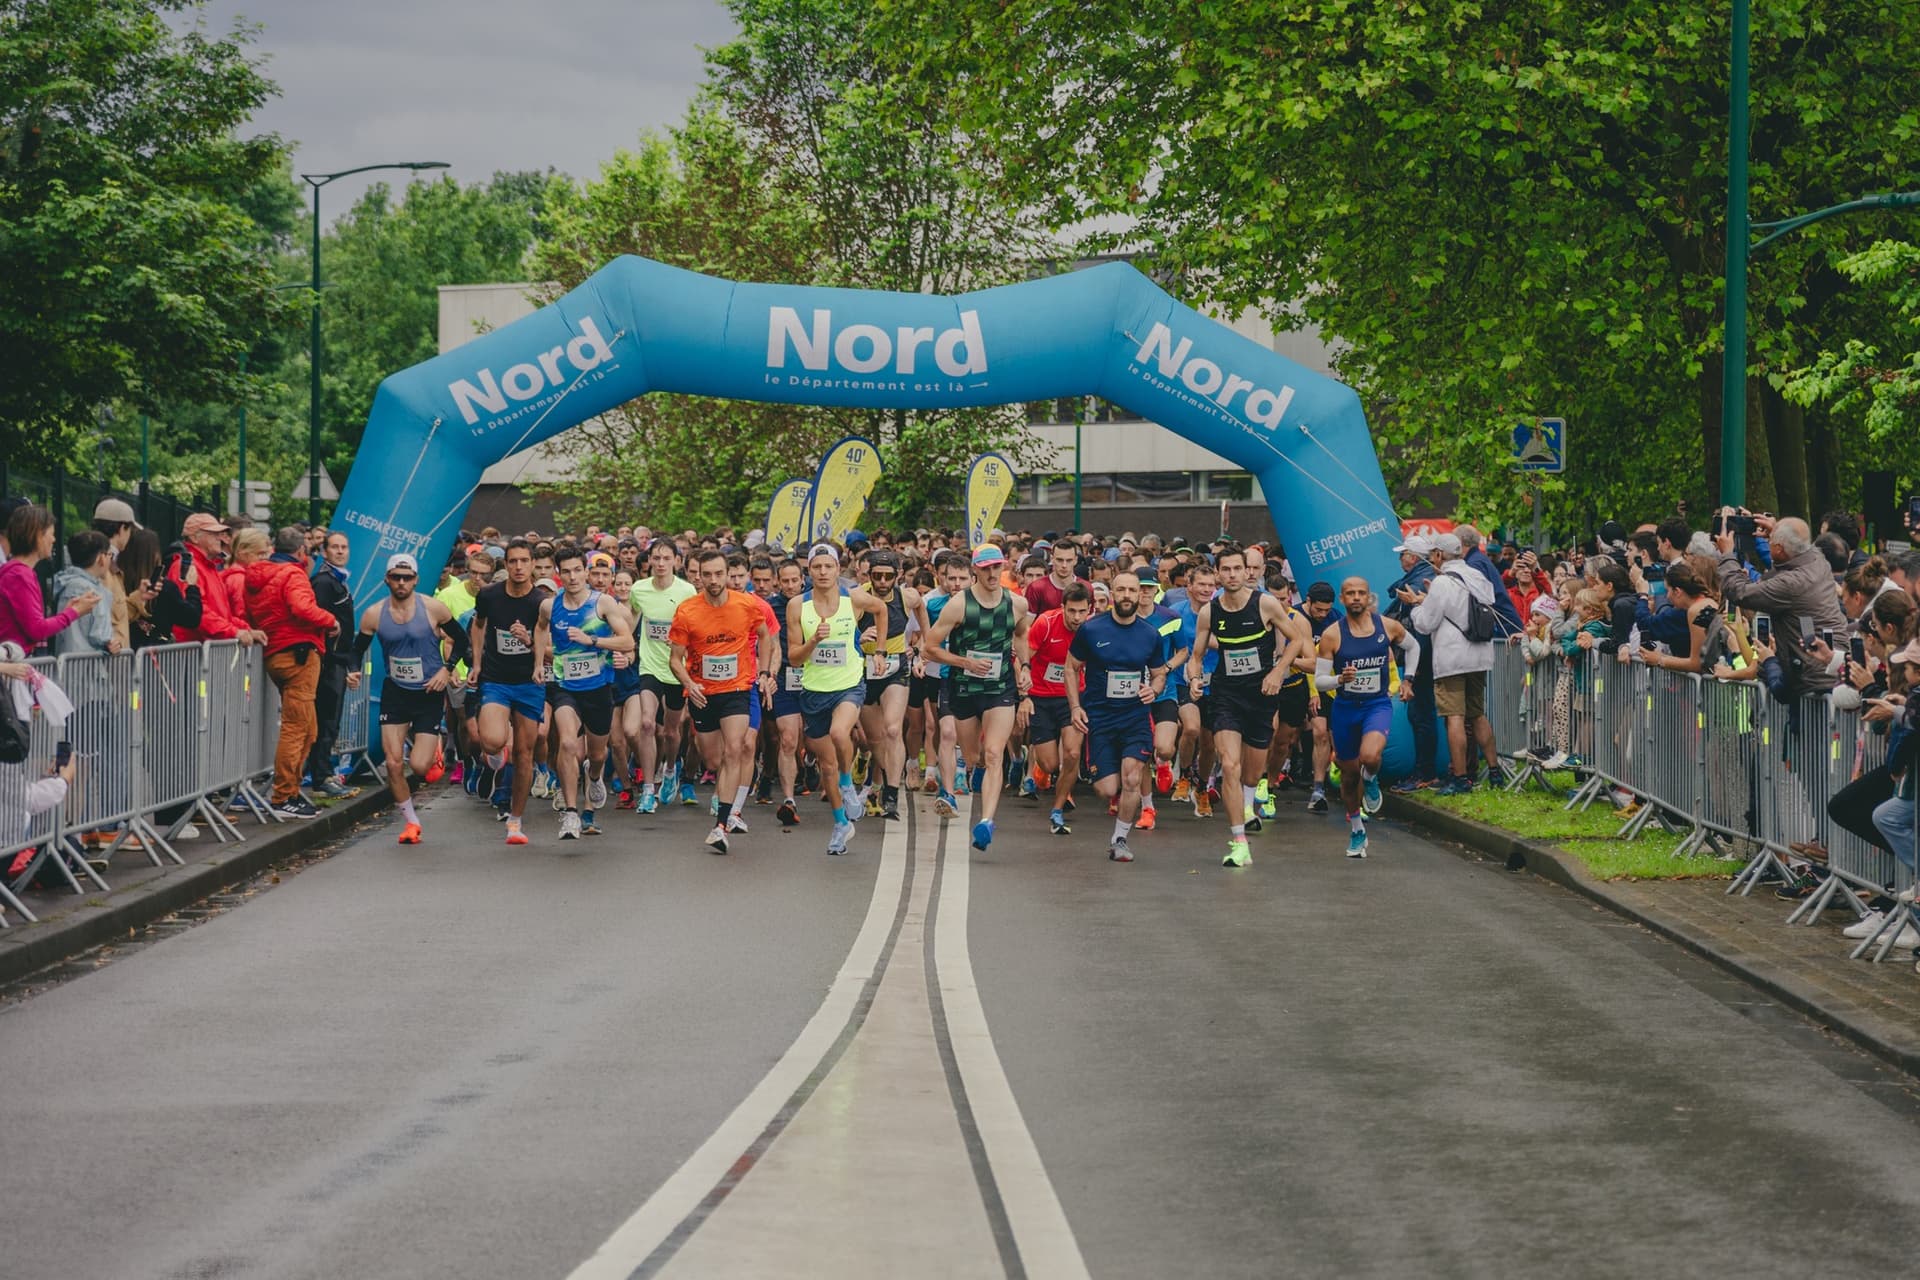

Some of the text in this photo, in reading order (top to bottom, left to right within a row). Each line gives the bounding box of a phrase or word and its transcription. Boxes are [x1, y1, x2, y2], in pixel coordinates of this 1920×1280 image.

[767, 306, 988, 377] Nord
[448, 316, 614, 425] Nord
[1135, 321, 1296, 432] Nord
[765, 374, 964, 392] le Département est là
[1127, 363, 1140, 375] le
[1142, 372, 1218, 417] Département
[471, 426, 485, 437] le
[488, 389, 568, 430] Département
[345, 509, 358, 524] LE
[1305, 541, 1319, 554] LE
[1310, 551, 1328, 566] EST
[651, 625, 667, 635] 355
[818, 649, 837, 658] 461
[571, 661, 590, 672] 379
[711, 664, 730, 673] 293
[1232, 657, 1250, 667] 341
[396, 665, 414, 674] 465
[1119, 681, 1132, 690] 54
[1353, 677, 1372, 686] 327
